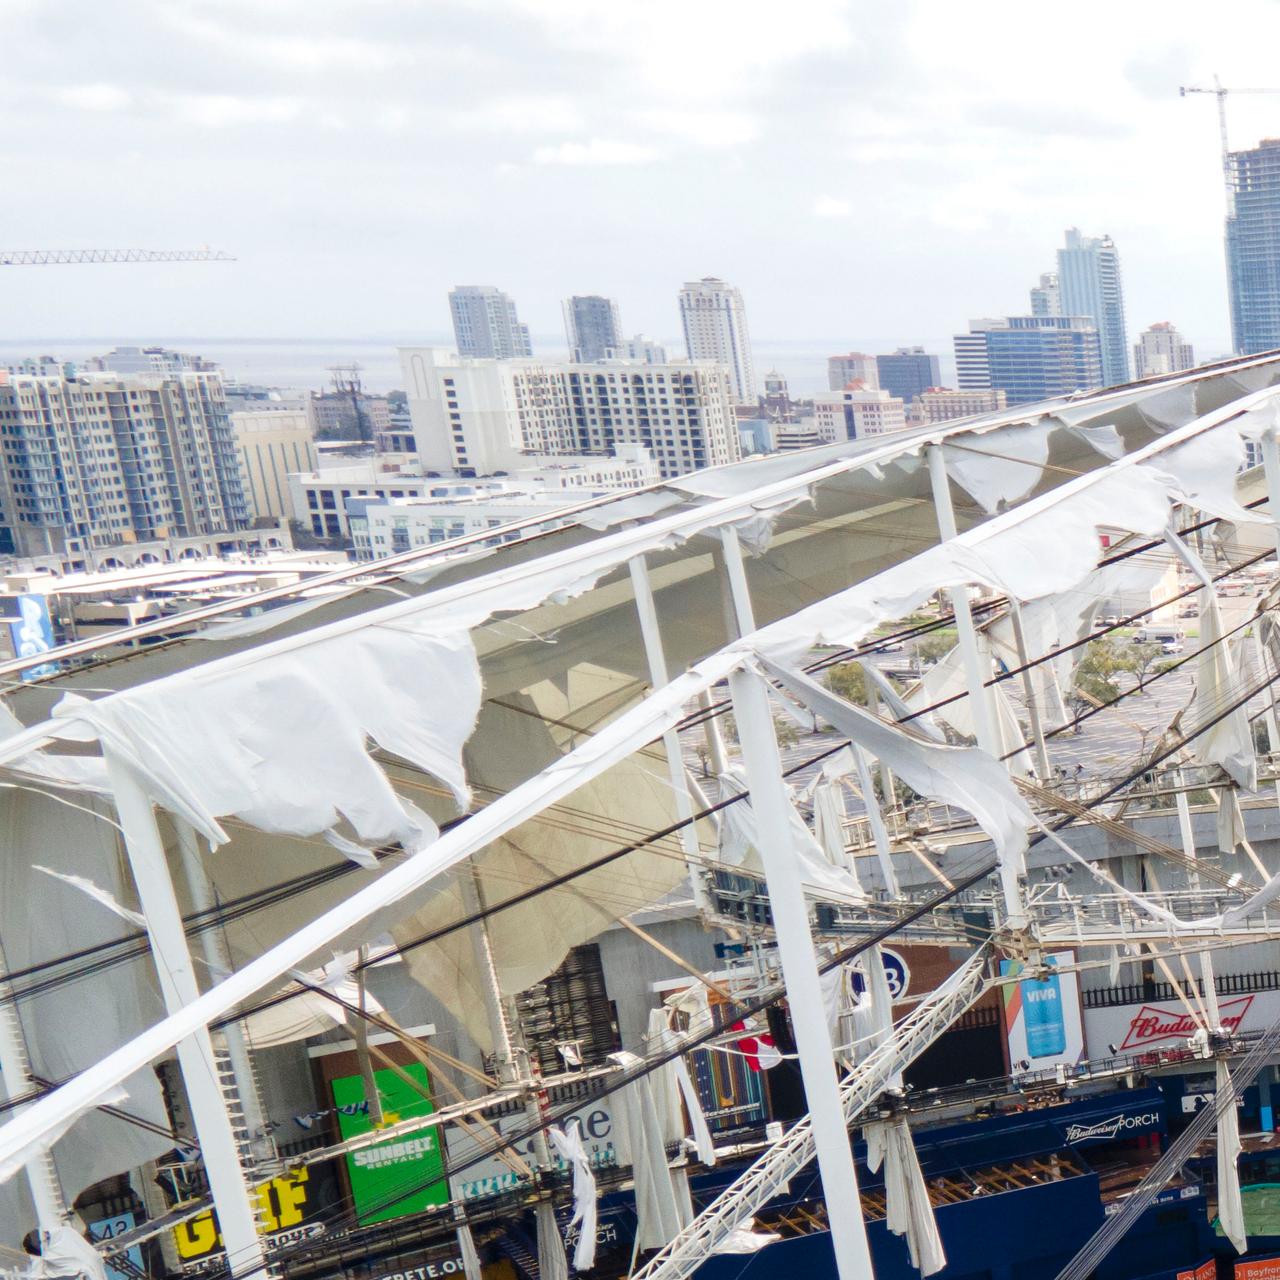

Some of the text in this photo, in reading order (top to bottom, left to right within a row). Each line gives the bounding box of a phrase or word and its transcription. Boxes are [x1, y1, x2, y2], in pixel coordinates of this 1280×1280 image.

[1026, 988, 1057, 1003] VIVA
[1066, 1111, 1160, 1142] Budweiser PORCH
[352, 1135, 434, 1168] SUNBELT
[366, 1152, 424, 1171] RENTALS
[266, 1226, 315, 1250] ROUP
[563, 1229, 617, 1250] POCH
